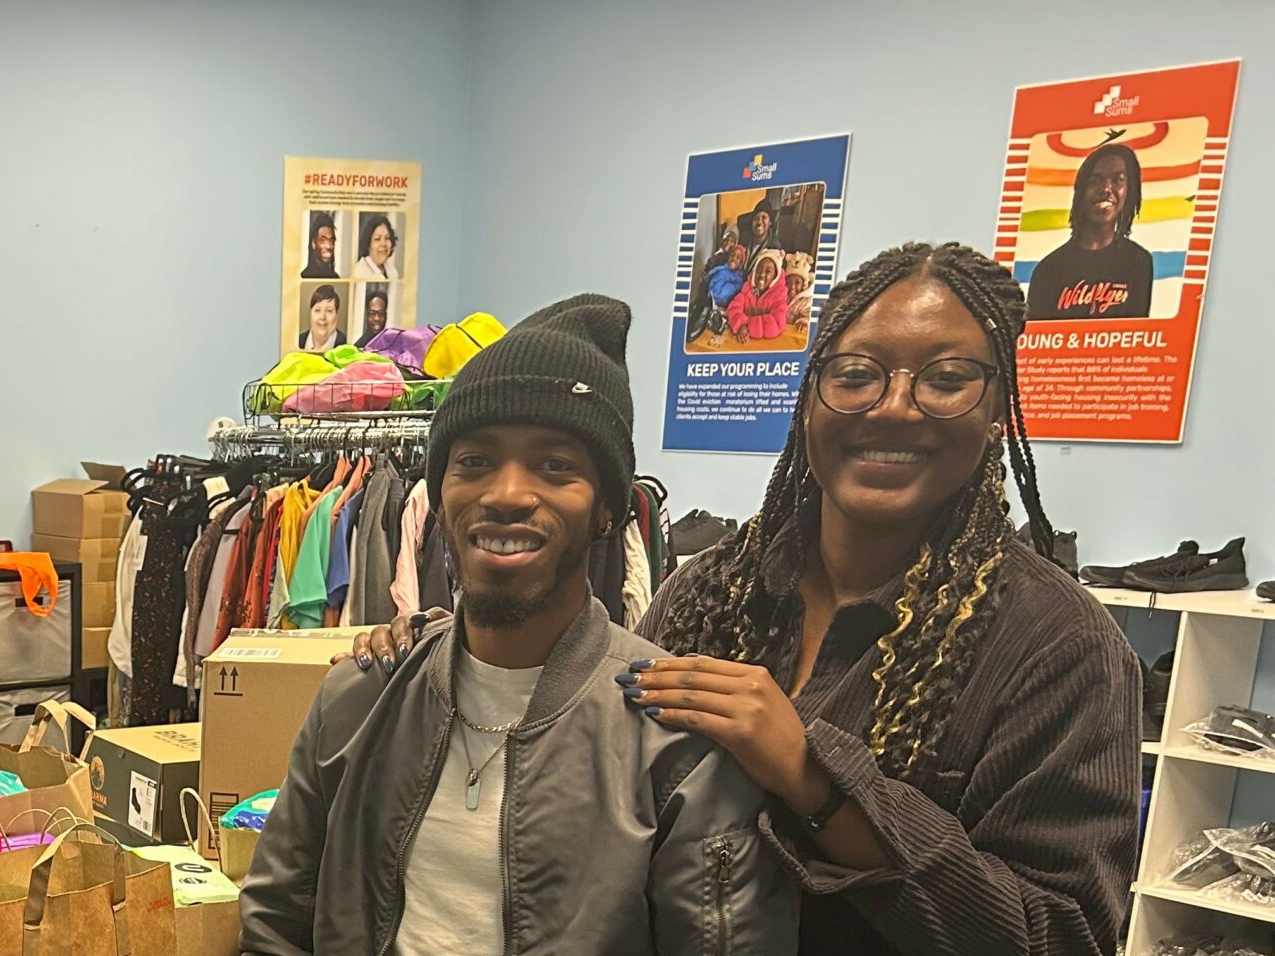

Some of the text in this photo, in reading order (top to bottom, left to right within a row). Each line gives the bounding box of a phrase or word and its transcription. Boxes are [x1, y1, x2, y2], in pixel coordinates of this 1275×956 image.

[1112, 96, 1140, 108] Small
[1105, 106, 1133, 117] Sums
[756, 162, 777, 173] Small
[304, 173, 408, 188] #READYFORWORK
[752, 171, 772, 181] Sums
[1017, 331, 1167, 349] OUNG & HOPEFUL
[687, 361, 800, 377] KEEP YOUR PLACE
